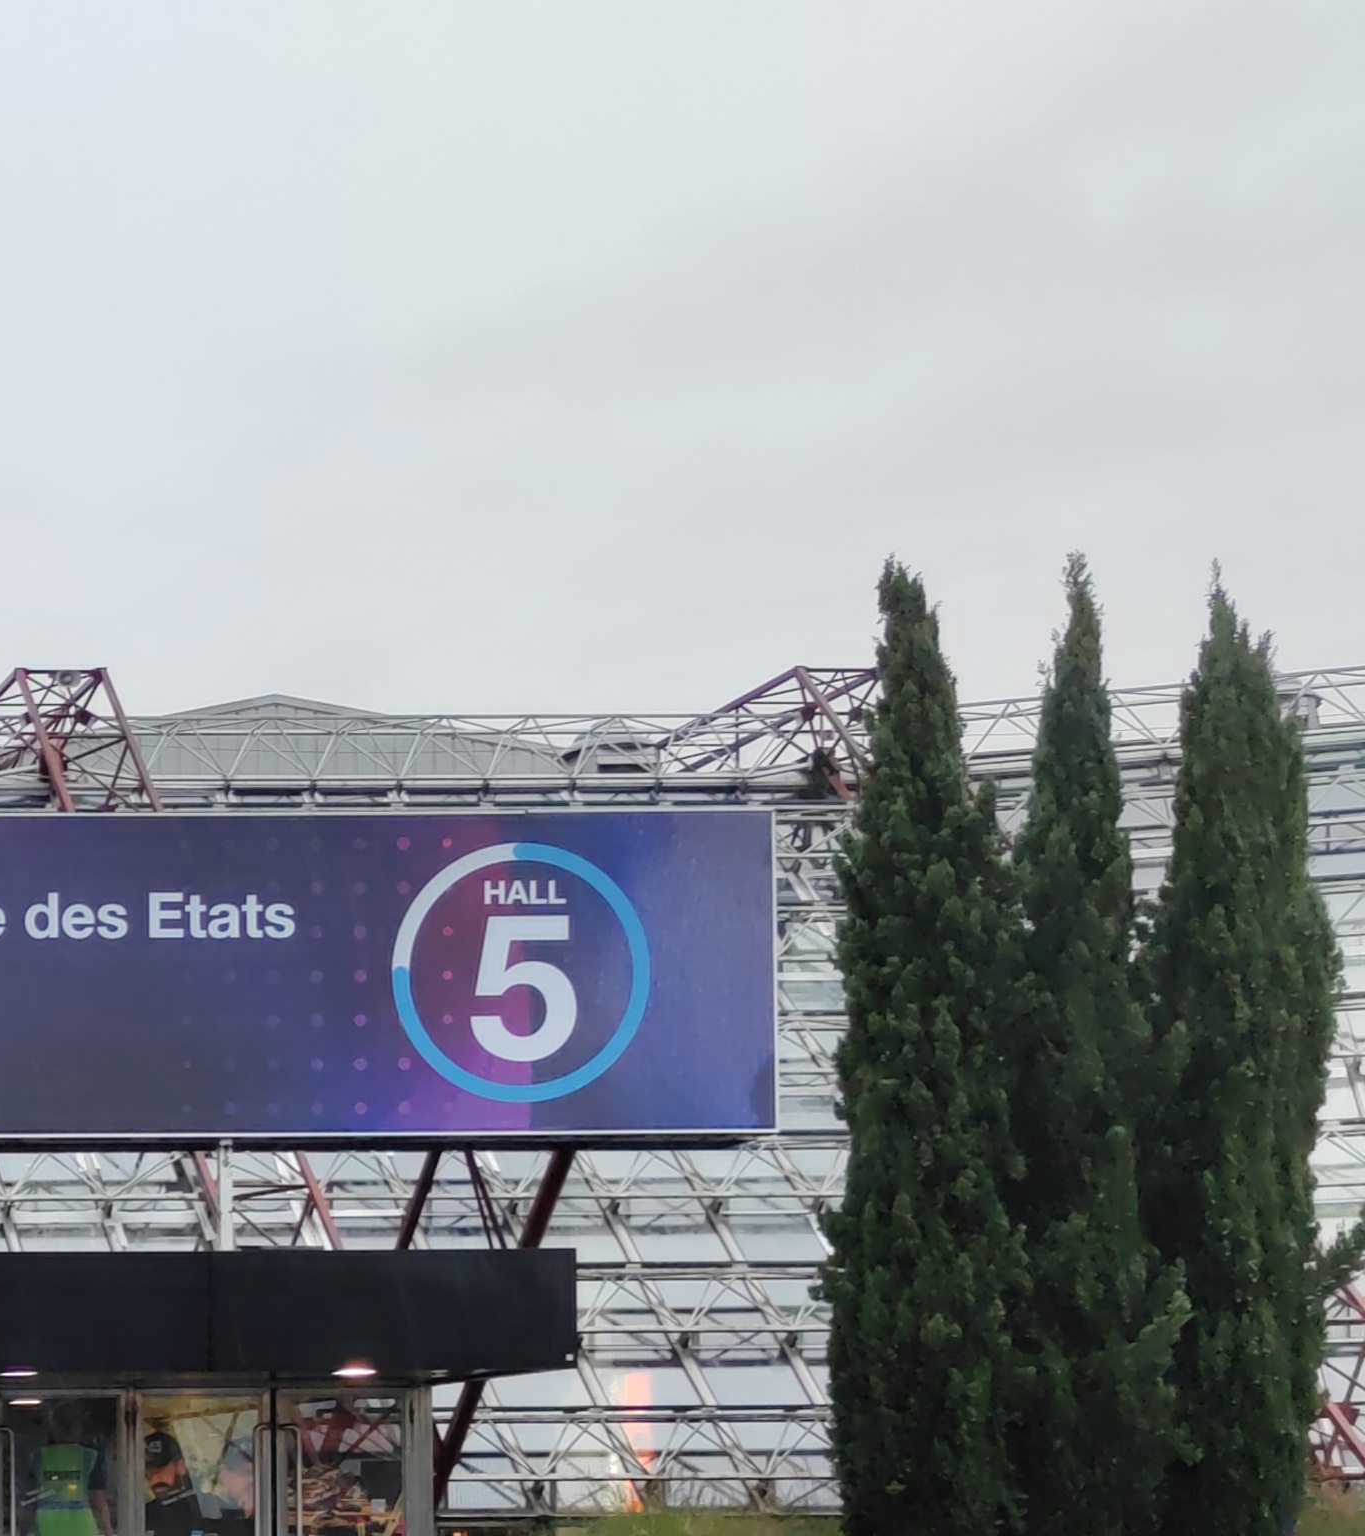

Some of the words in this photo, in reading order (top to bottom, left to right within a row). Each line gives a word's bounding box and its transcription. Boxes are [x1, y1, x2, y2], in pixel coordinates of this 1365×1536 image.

[24, 892, 129, 940] des
[148, 892, 297, 940] Etats
[484, 880, 567, 905] HALL
[470, 915, 578, 1062] 5
